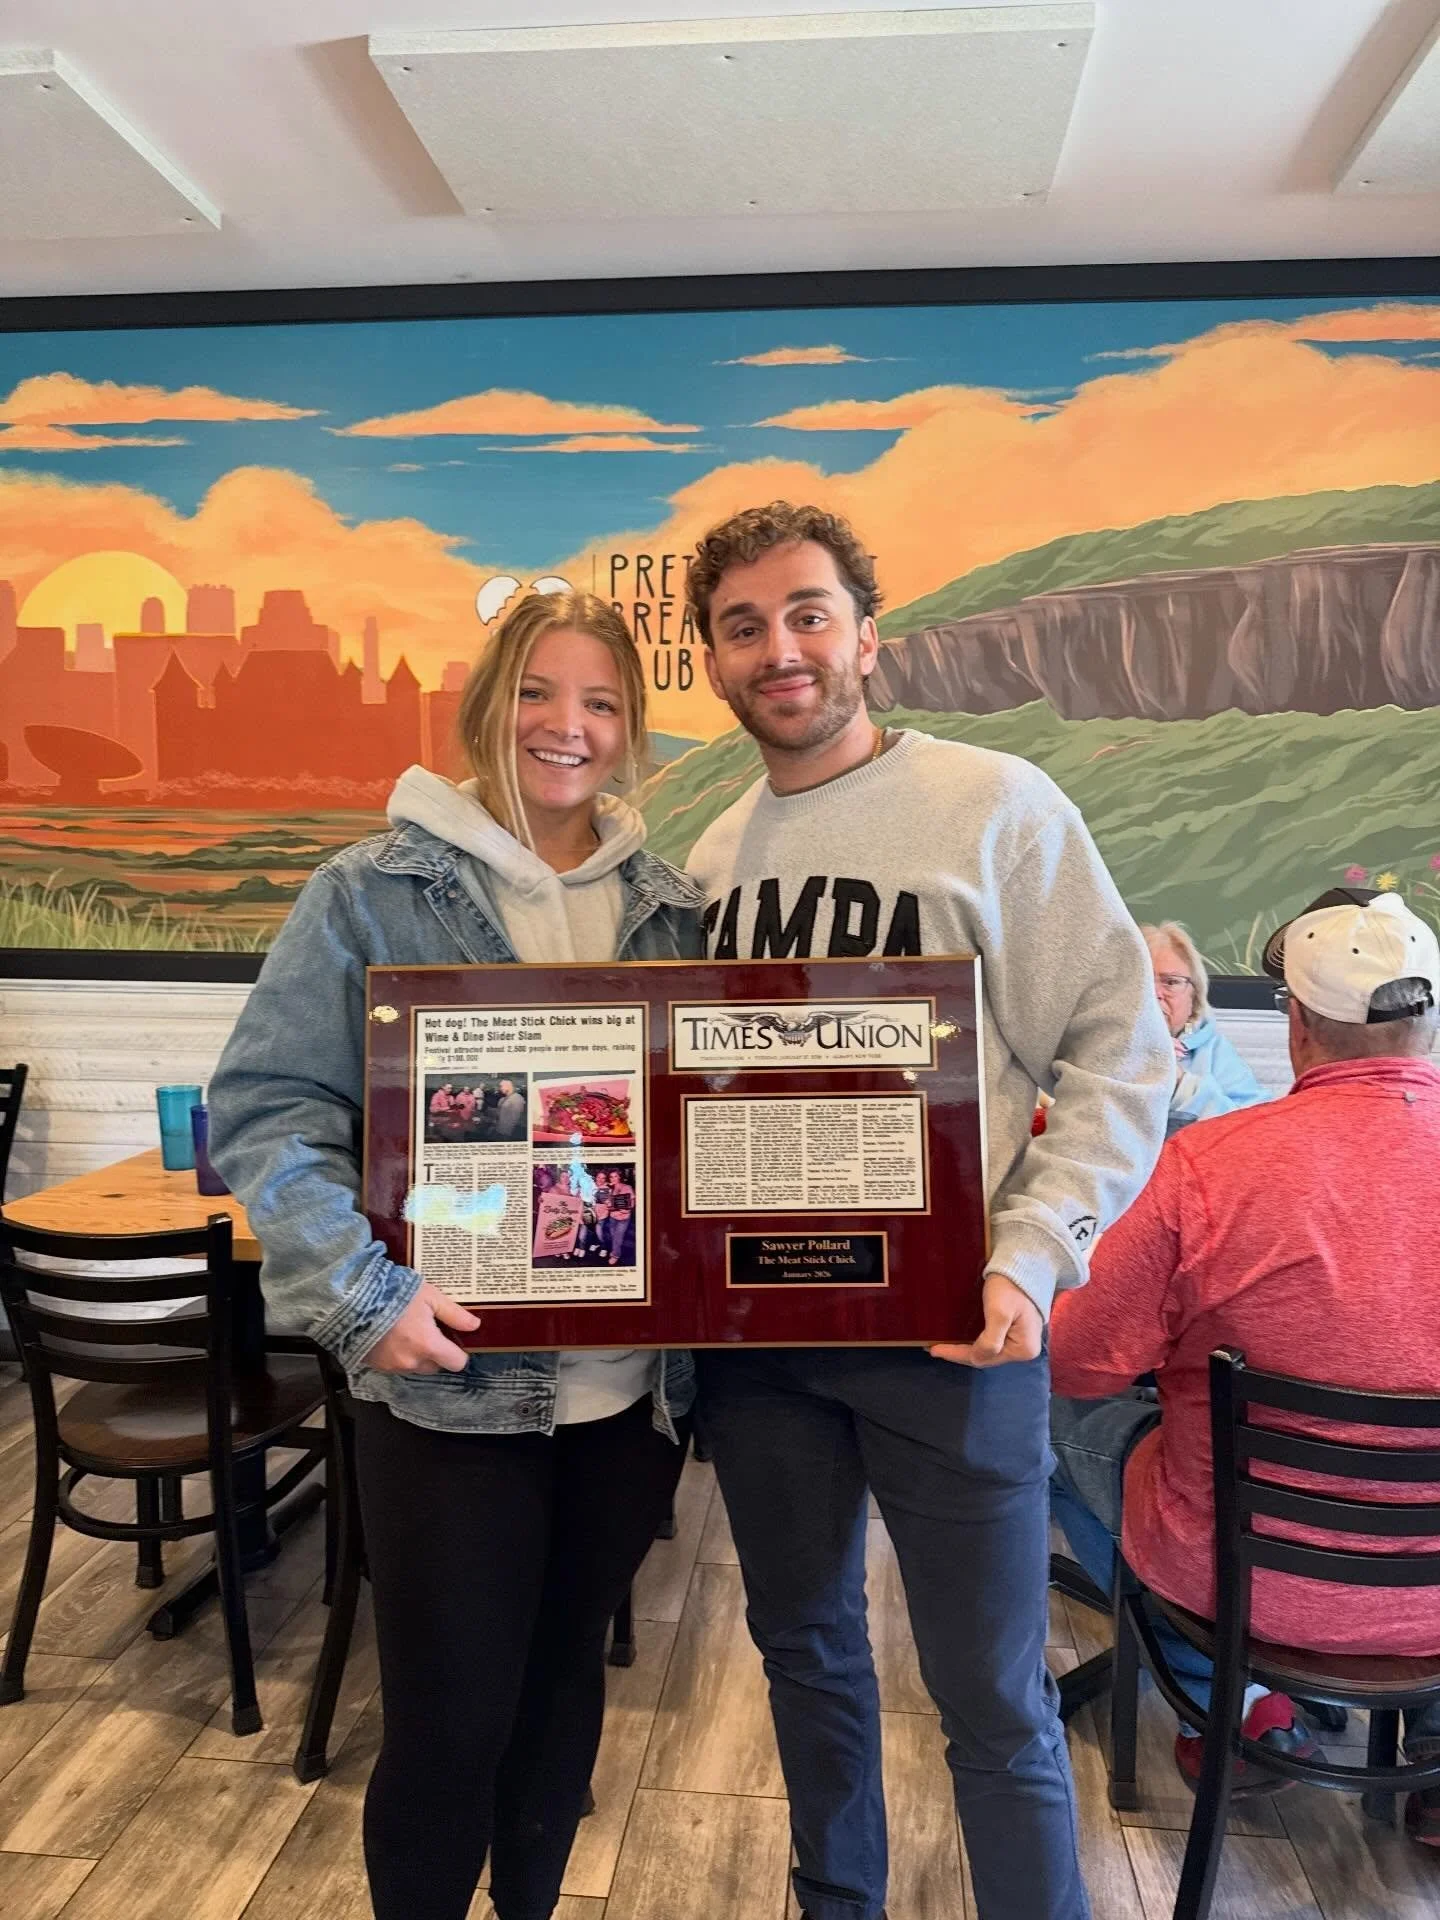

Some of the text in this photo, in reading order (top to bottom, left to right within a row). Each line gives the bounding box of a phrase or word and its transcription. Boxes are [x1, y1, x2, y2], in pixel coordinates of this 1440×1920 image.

[611, 554, 694, 598] PRET
[654, 649, 694, 691] UB
[425, 1015, 636, 1029] Hot dog! The Meat Stick Chick wins big at
[425, 1031, 542, 1042] Wine & Dine Slider Slam
[682, 1017, 922, 1051] TIMES UNION
[425, 1046, 451, 1054] Festival
[528, 1045, 552, 1053] people
[572, 1044, 589, 1052] three
[612, 1044, 636, 1052] raising
[761, 1239, 851, 1253] Sawyer Pollard
[758, 1255, 857, 1265] The Meat Stick Chick
[781, 1271, 812, 1279] January
